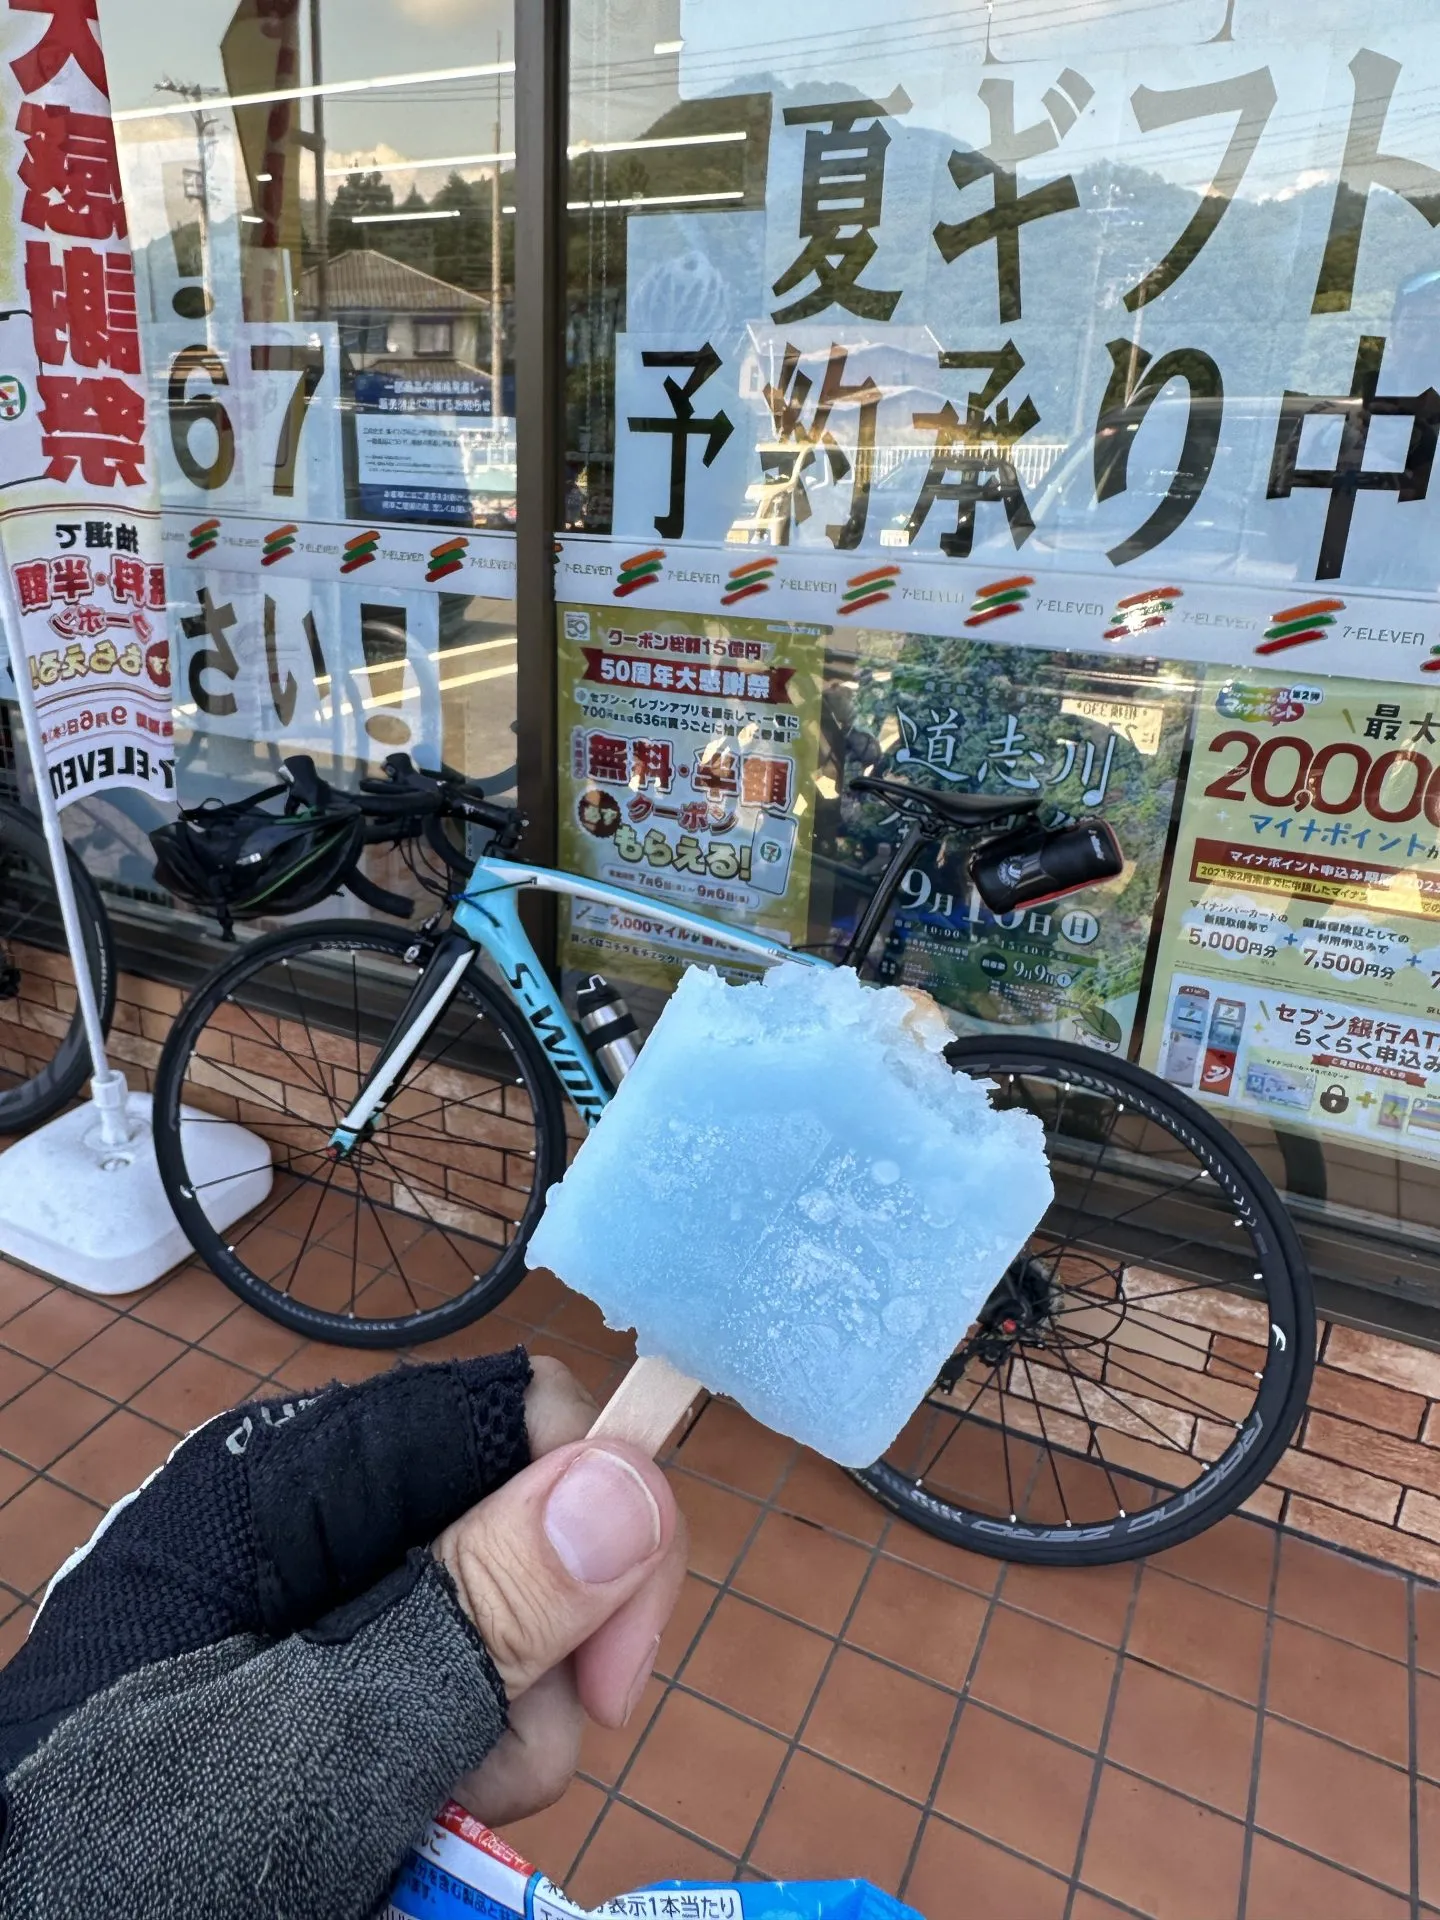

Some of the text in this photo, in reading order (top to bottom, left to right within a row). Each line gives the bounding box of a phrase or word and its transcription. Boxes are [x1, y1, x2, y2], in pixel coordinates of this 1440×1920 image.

[771, 48, 1440, 325] 夏ギフト
[626, 335, 1438, 581] 予約承り中
[600, 658, 771, 699] 50周年大感謝祭
[1204, 730, 1440, 829] 20,00
[627, 793, 739, 836] クーポン
[613, 822, 752, 881] もらえる!
[1188, 927, 1278, 959] 5,000円分
[1303, 948, 1396, 981] 7,500円分
[1275, 1002, 1440, 1053] セブン銀行AT
